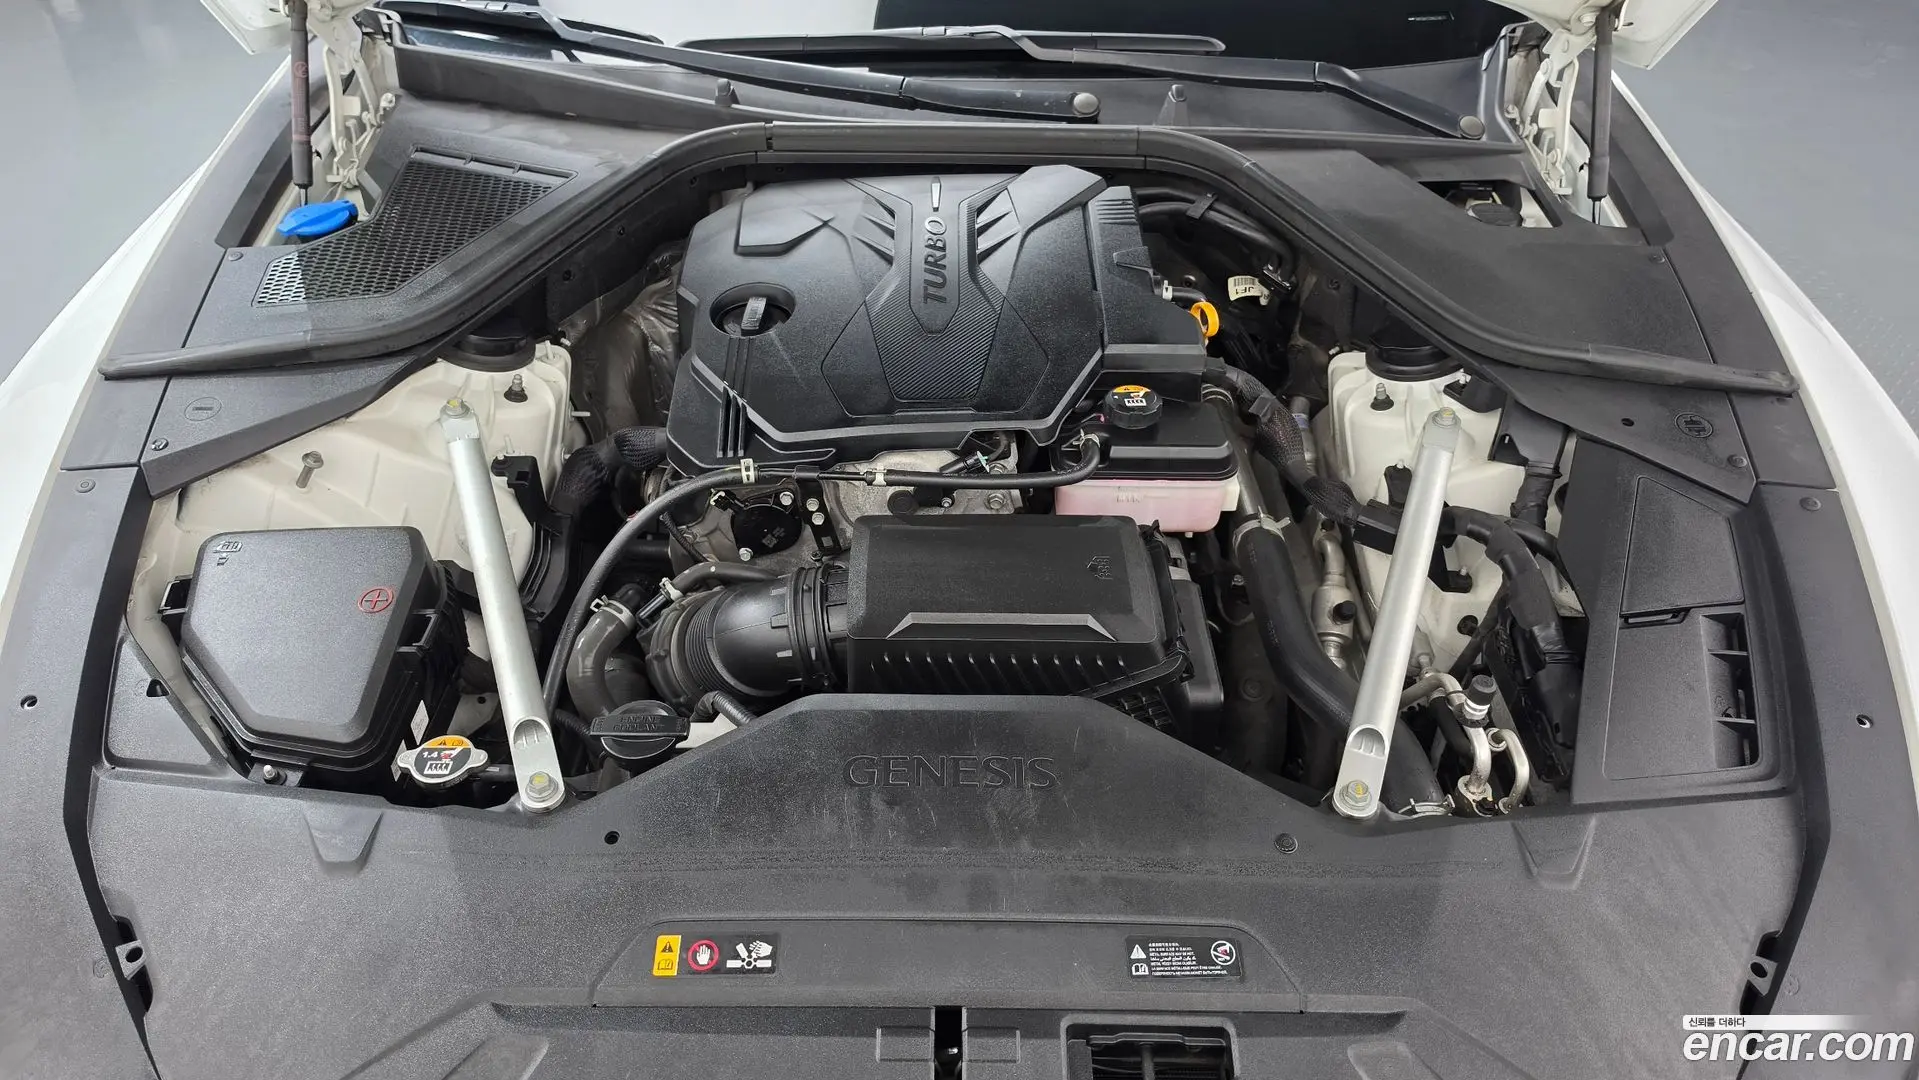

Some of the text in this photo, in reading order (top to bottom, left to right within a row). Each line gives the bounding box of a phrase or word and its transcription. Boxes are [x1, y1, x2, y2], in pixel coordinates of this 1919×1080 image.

[923, 216, 947, 305] TURBO
[1235, 286, 1255, 295] JF1
[422, 751, 438, 759] 1.4
[843, 755, 1060, 788] GENESIS
